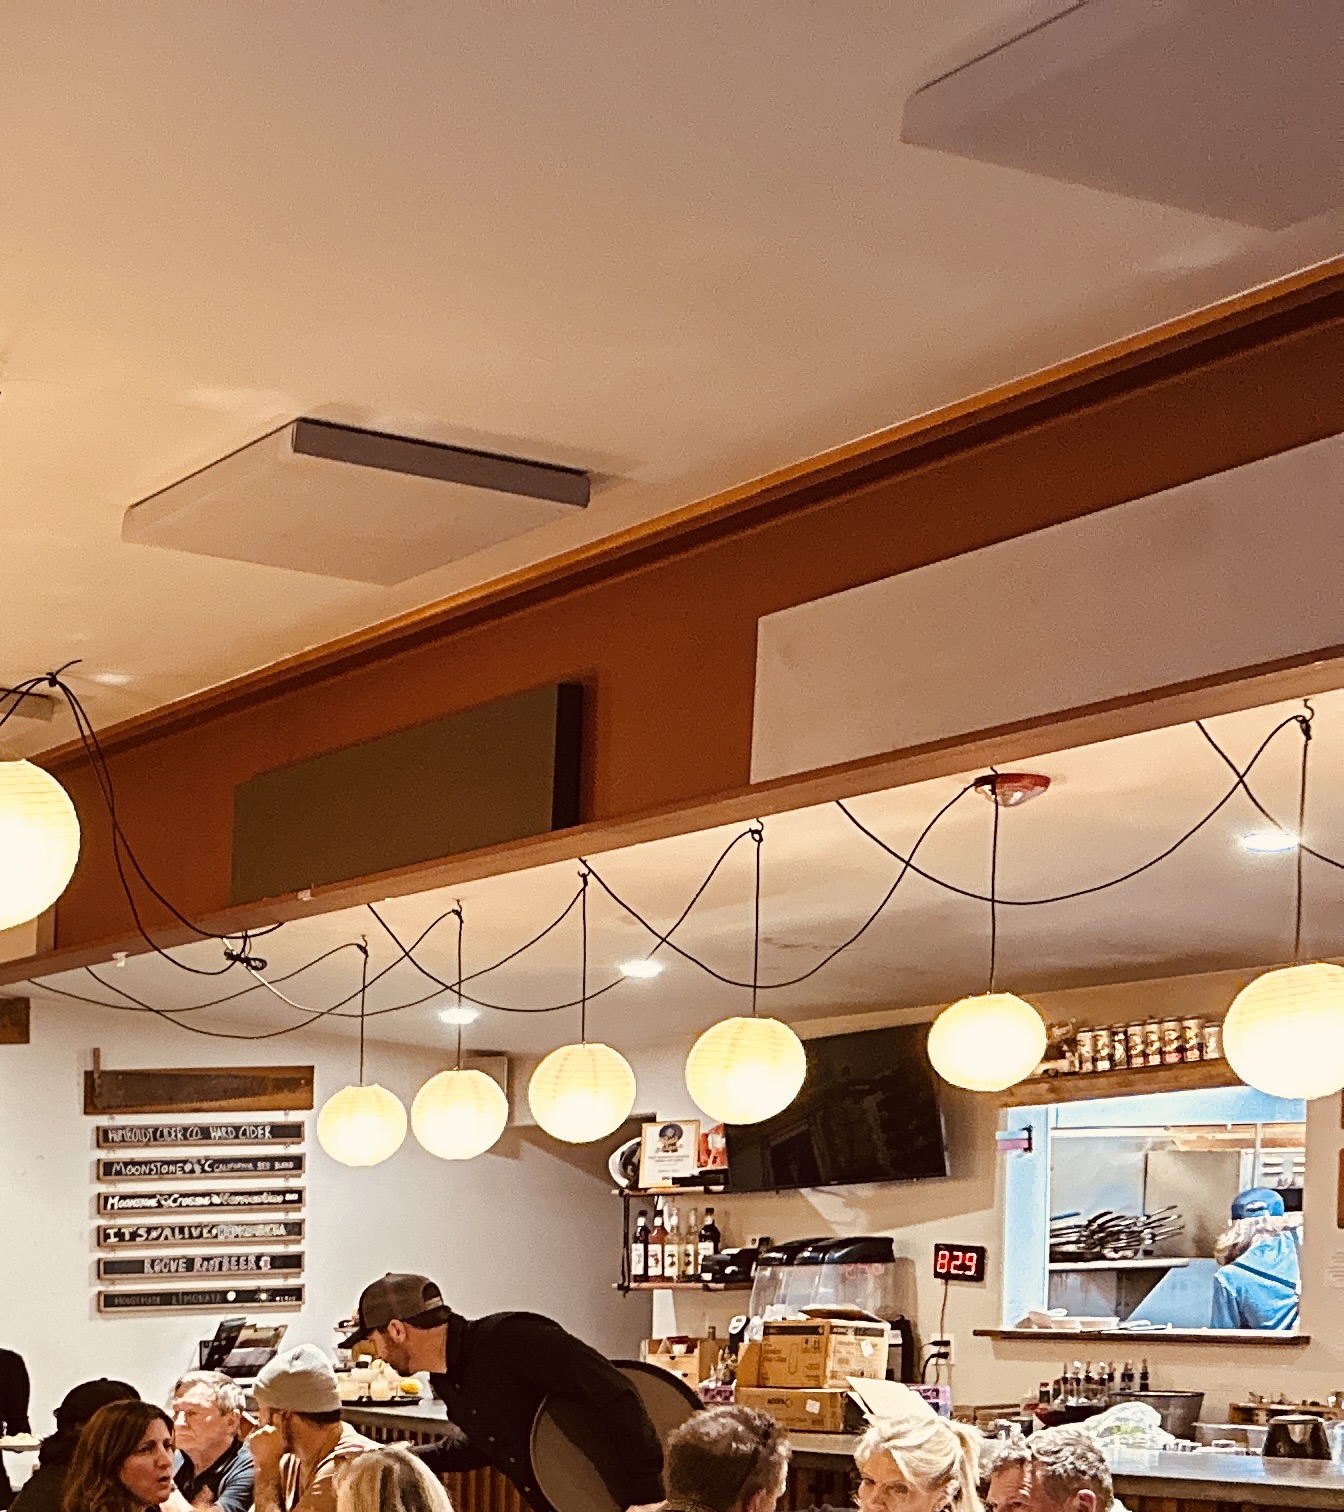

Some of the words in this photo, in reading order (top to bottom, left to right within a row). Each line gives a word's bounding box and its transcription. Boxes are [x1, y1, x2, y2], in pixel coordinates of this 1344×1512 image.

[209, 1126, 236, 1140] HARD
[238, 1125, 272, 1140] CIDER
[112, 1162, 184, 1176] MOONSTONE
